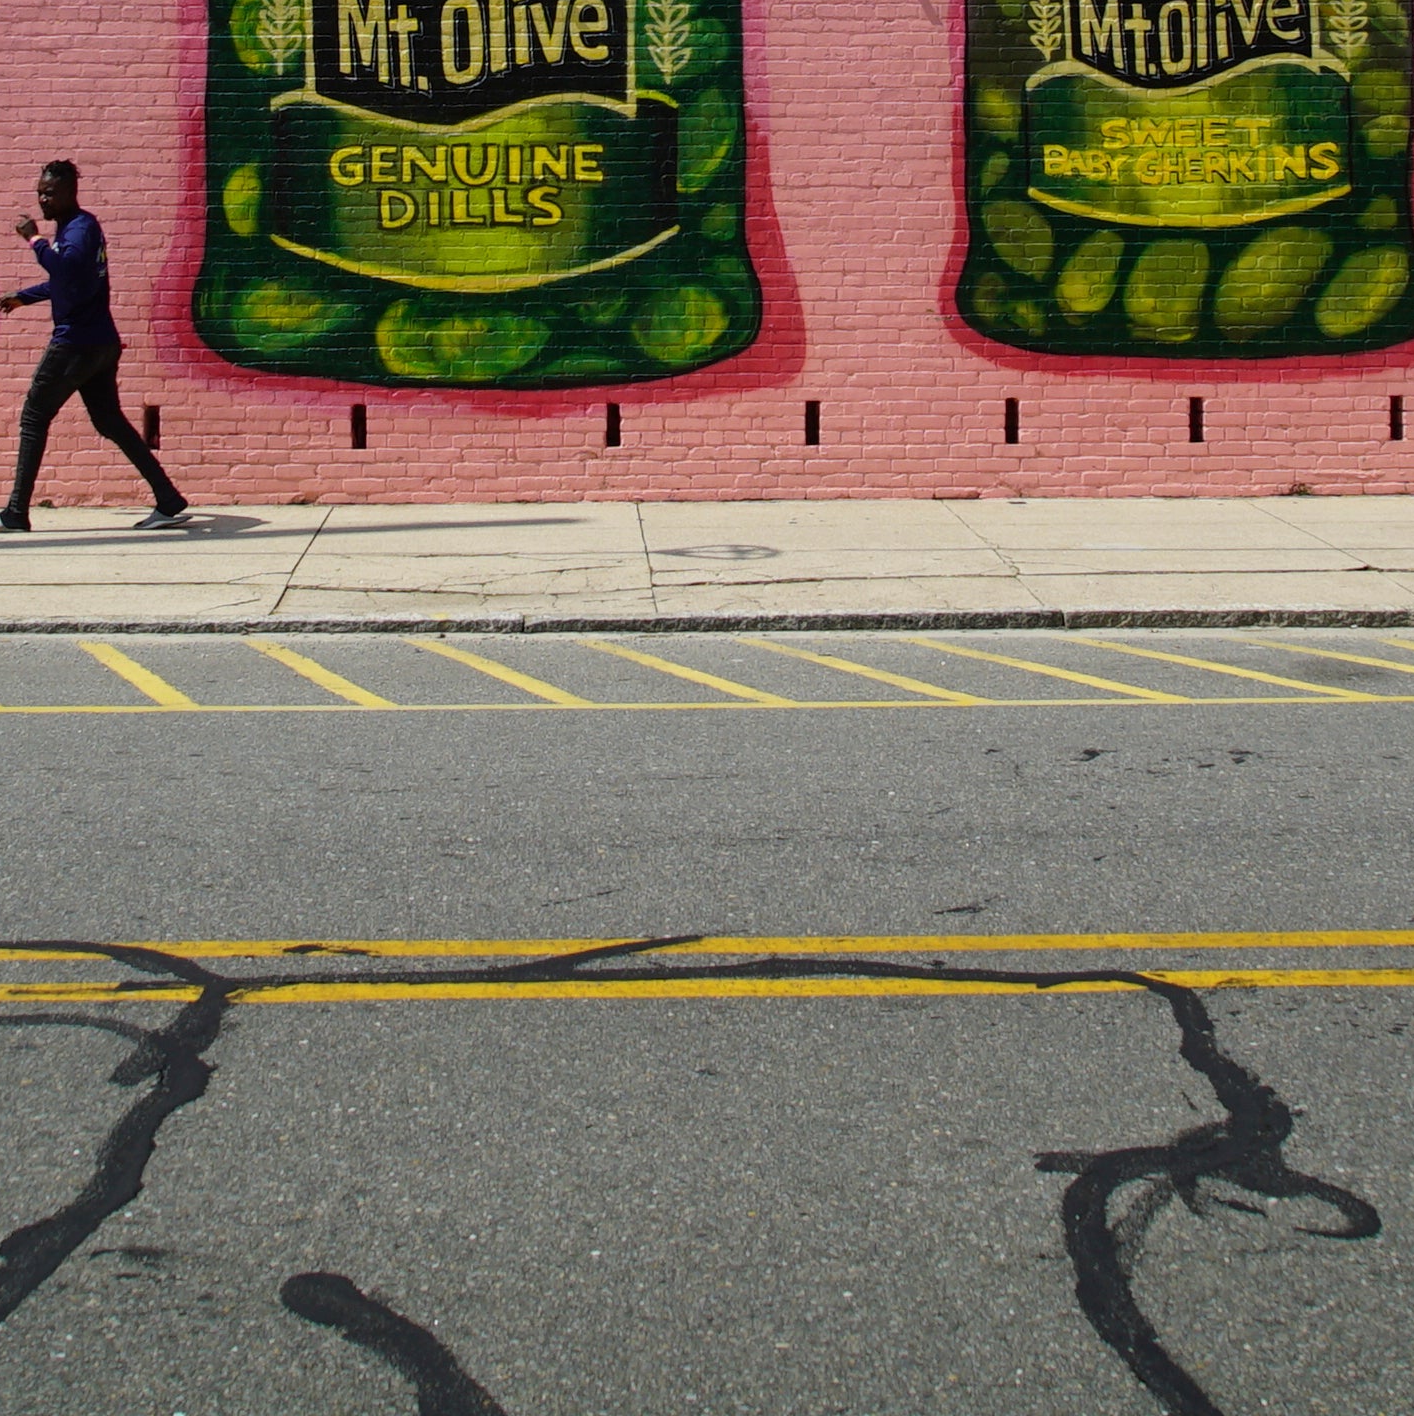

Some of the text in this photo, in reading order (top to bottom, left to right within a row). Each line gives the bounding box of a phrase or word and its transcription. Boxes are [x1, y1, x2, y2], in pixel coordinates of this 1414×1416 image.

[1102, 117, 1271, 149] SWEET
[329, 144, 604, 187] GENUINE
[1043, 142, 1341, 184] BABY GHERKINS
[378, 186, 564, 230] DILLS
